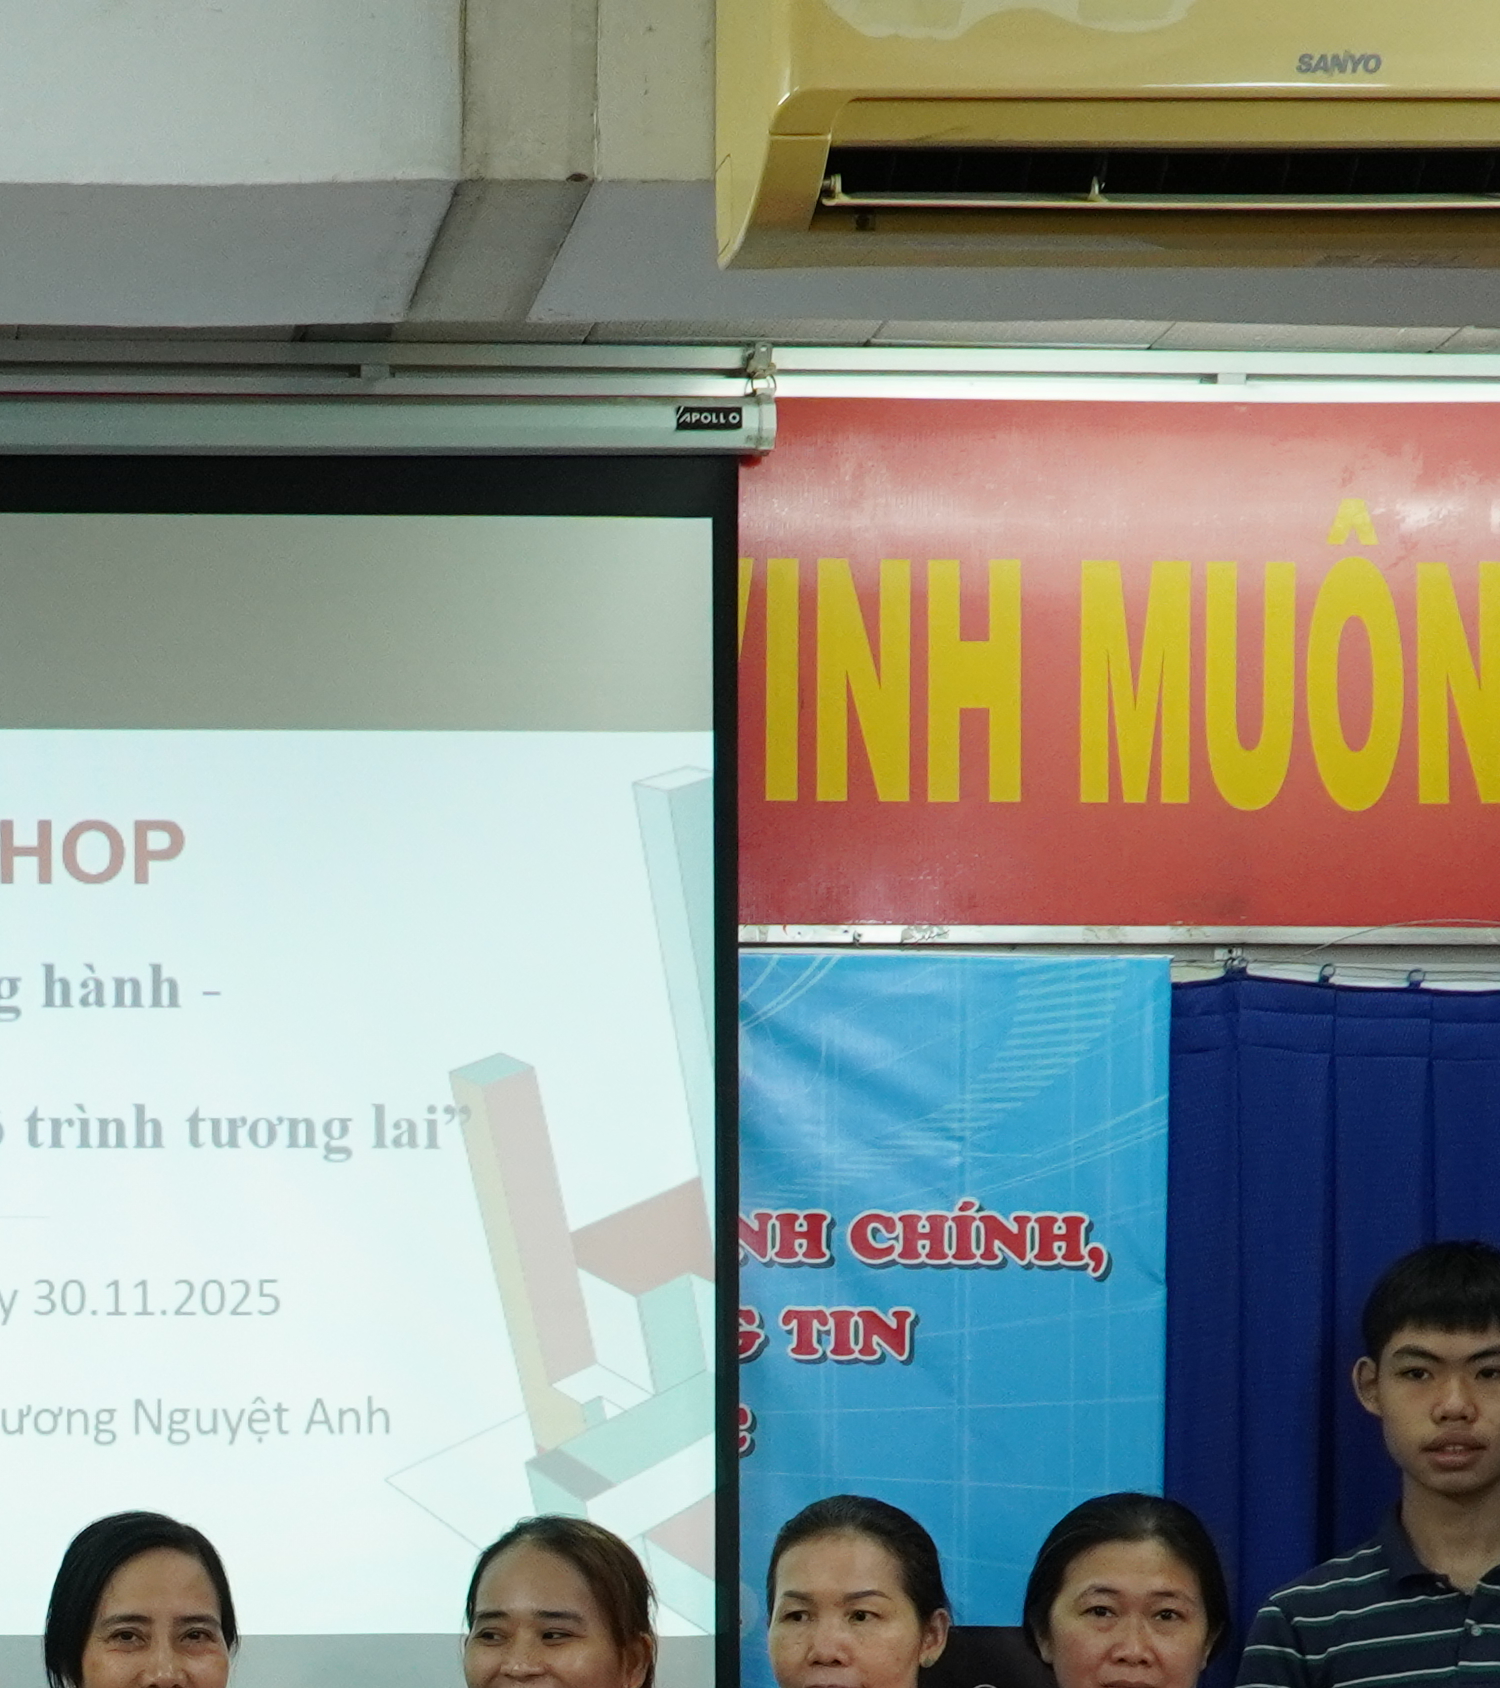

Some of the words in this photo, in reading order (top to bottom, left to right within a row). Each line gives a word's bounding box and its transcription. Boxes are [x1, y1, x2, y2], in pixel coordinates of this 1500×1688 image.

[1296, 53, 1382, 75] SANYO
[678, 410, 741, 424] APOLLO
[738, 557, 1022, 803] INH
[40, 962, 182, 1009] hành
[24, 1102, 166, 1150] trình
[185, 1105, 353, 1164] tương
[371, 1102, 471, 1150] lai”
[847, 1196, 1110, 1279] CHÍNH,
[33, 1278, 282, 1318] 30.11.2025
[778, 1305, 916, 1362] TIN
[133, 1397, 289, 1446] Nguyệt
[304, 1396, 392, 1435] Anh
